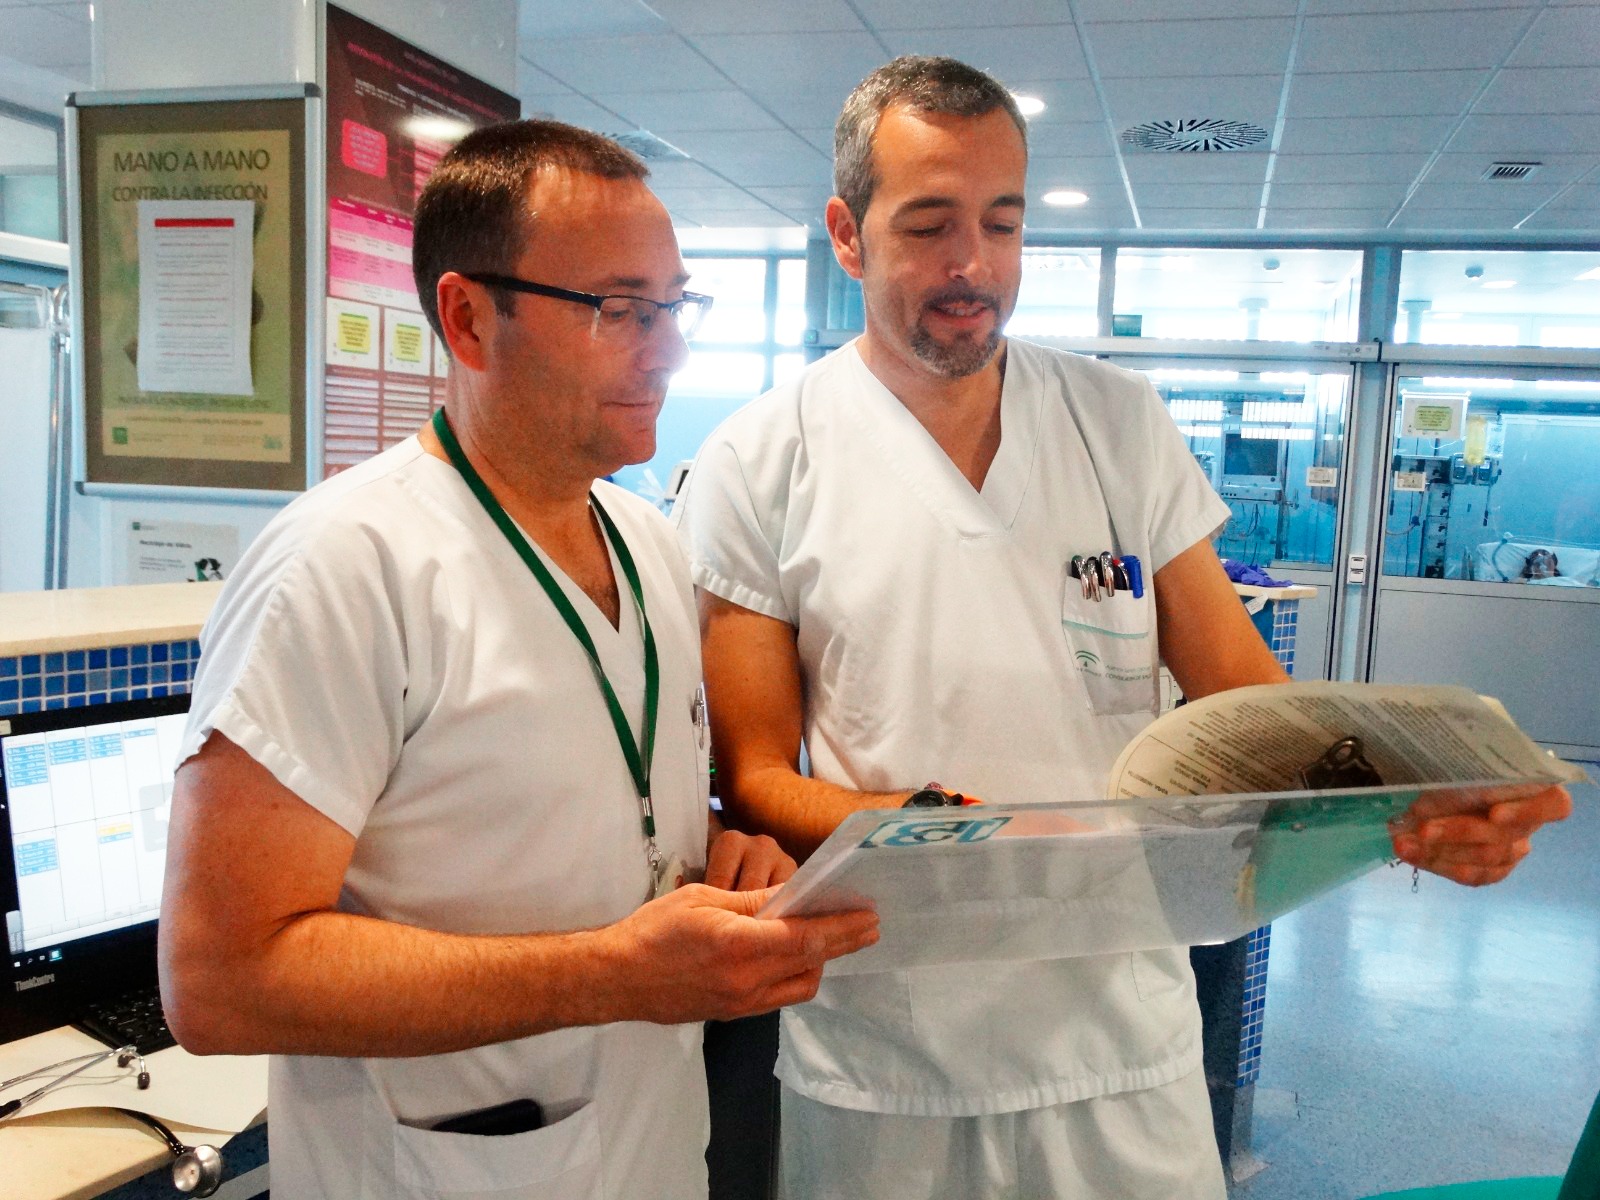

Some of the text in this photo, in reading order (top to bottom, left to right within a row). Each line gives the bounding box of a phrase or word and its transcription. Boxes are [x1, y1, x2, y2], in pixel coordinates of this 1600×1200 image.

[113, 149, 270, 172] MANO A MANO
[112, 186, 170, 201] CONTRA
[172, 186, 191, 200] LA
